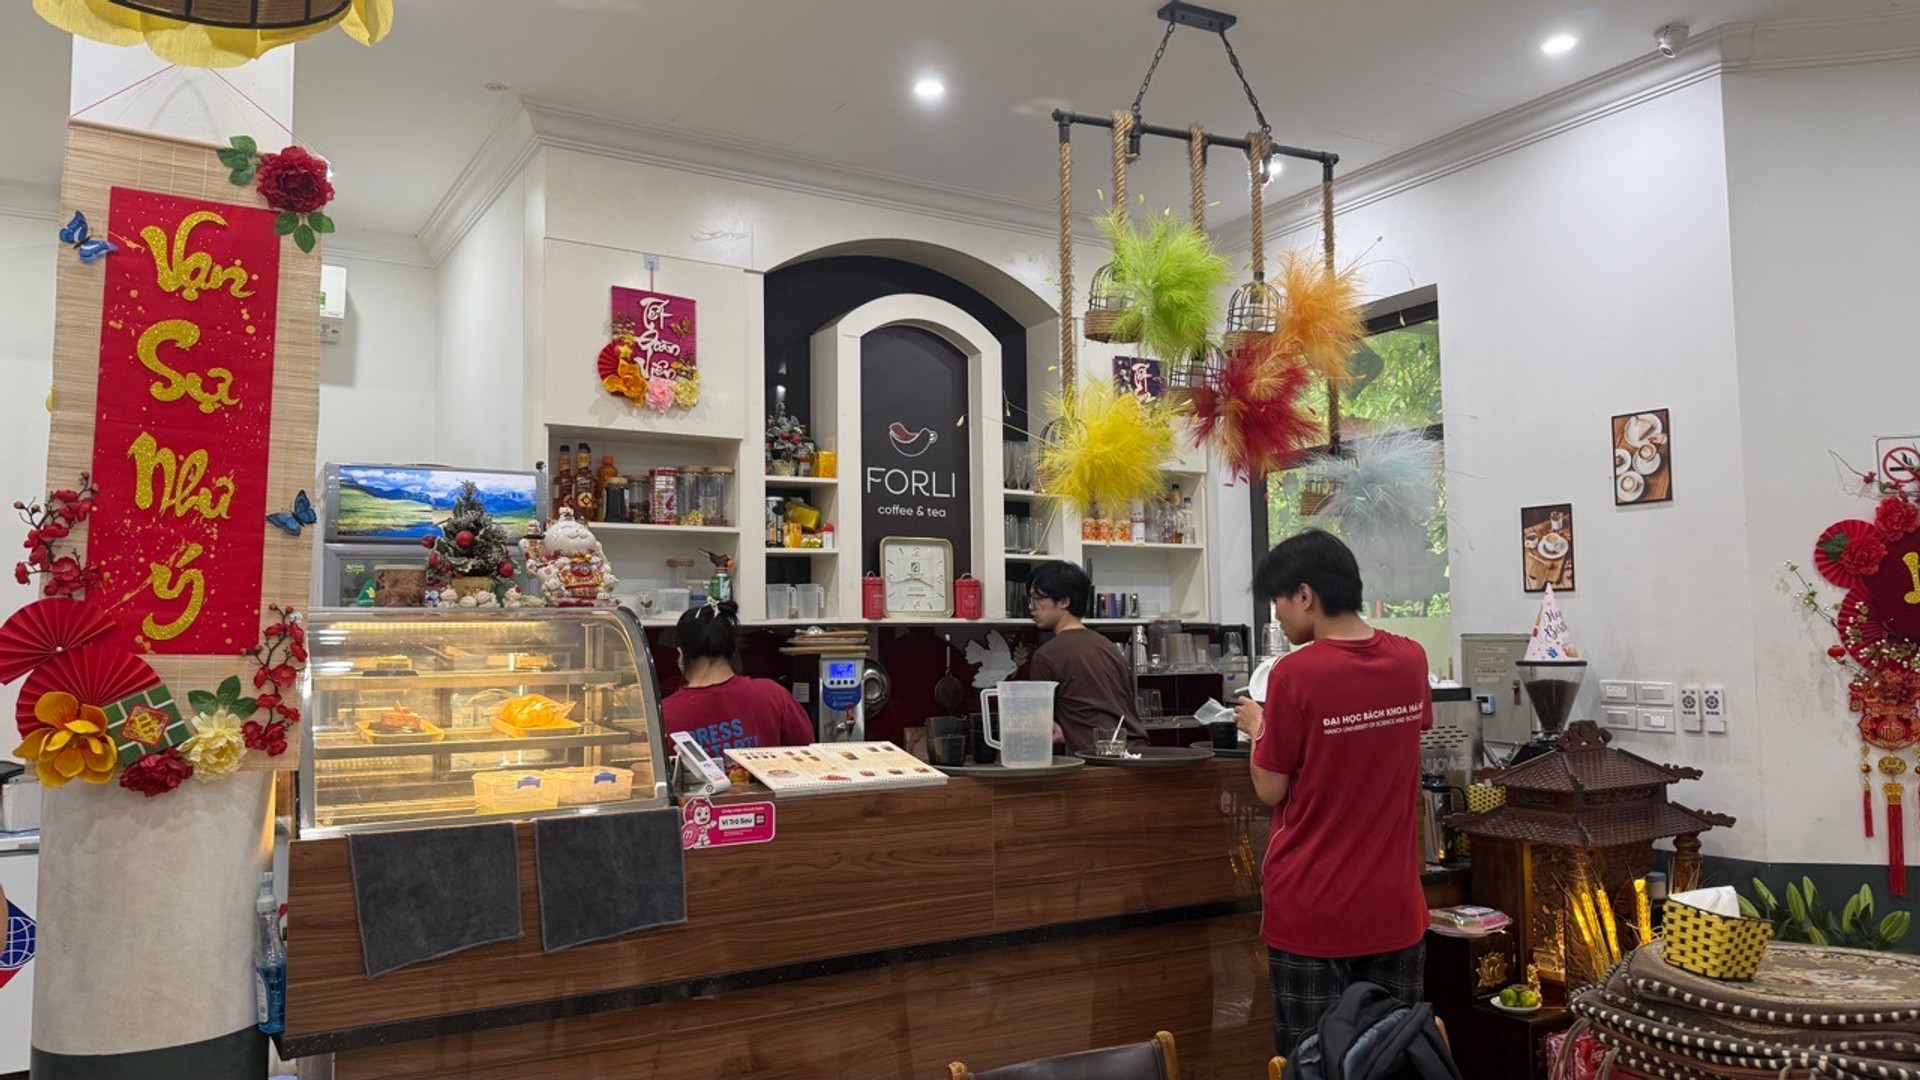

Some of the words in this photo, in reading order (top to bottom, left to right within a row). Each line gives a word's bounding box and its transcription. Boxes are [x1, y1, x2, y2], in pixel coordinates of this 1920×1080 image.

[139, 209, 257, 301] Vạn
[639, 297, 674, 330] Tết
[866, 466, 956, 498] FORLI
[877, 504, 914, 515] coffee
[916, 505, 924, 516] &
[927, 507, 946, 518] tea
[1323, 716, 1340, 728] ĐẠI
[1342, 714, 1362, 725] HỌC
[1363, 709, 1385, 722] BÁCH
[1386, 705, 1408, 717] KHOA
